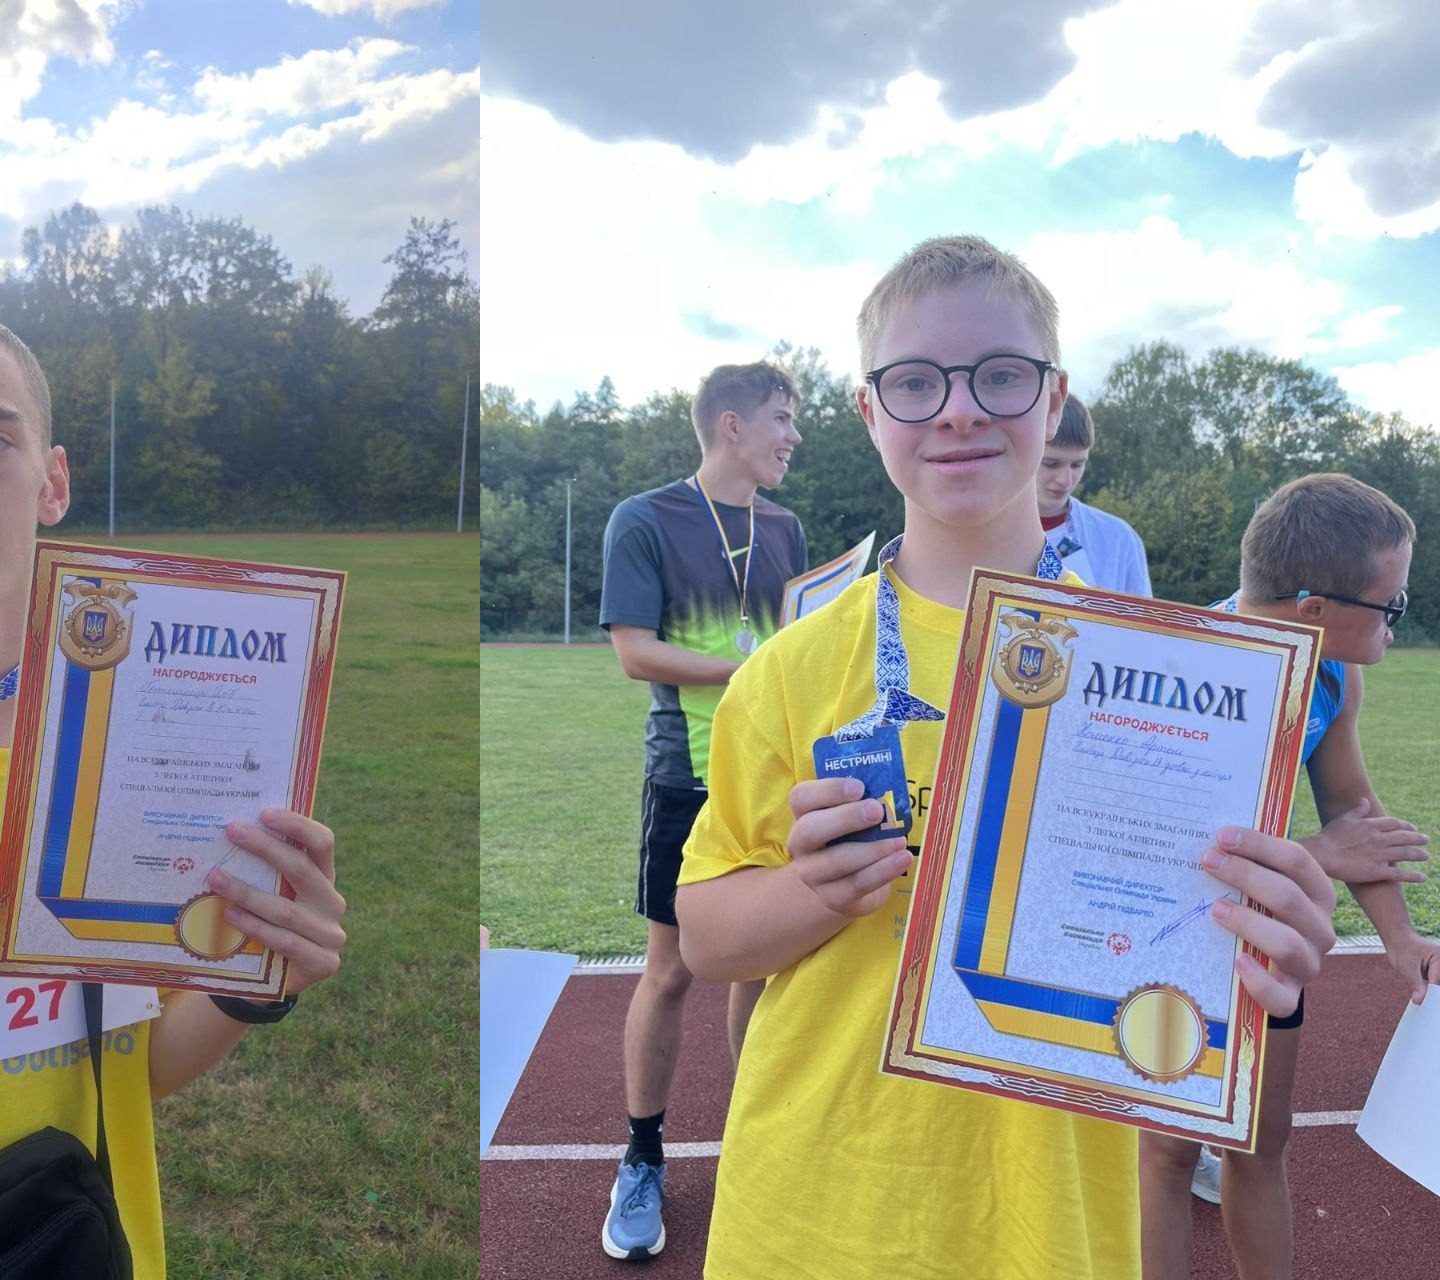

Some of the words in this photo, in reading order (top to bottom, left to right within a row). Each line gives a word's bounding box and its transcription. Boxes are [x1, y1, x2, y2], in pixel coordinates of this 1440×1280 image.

[144, 621, 287, 664] ДИПЛОМ
[153, 667, 257, 684] НАГОРОДЖУЄТЬСЯ
[1083, 661, 1248, 722] ДИПЛОМ
[1089, 710, 1209, 742] НАГОРОДЖУЄТЬСЯ
[825, 751, 893, 771] НЕСТРИМНІ
[877, 790, 905, 831] 1
[1168, 857, 1205, 872] УКРАЇН
[6, 979, 68, 1031] 27
